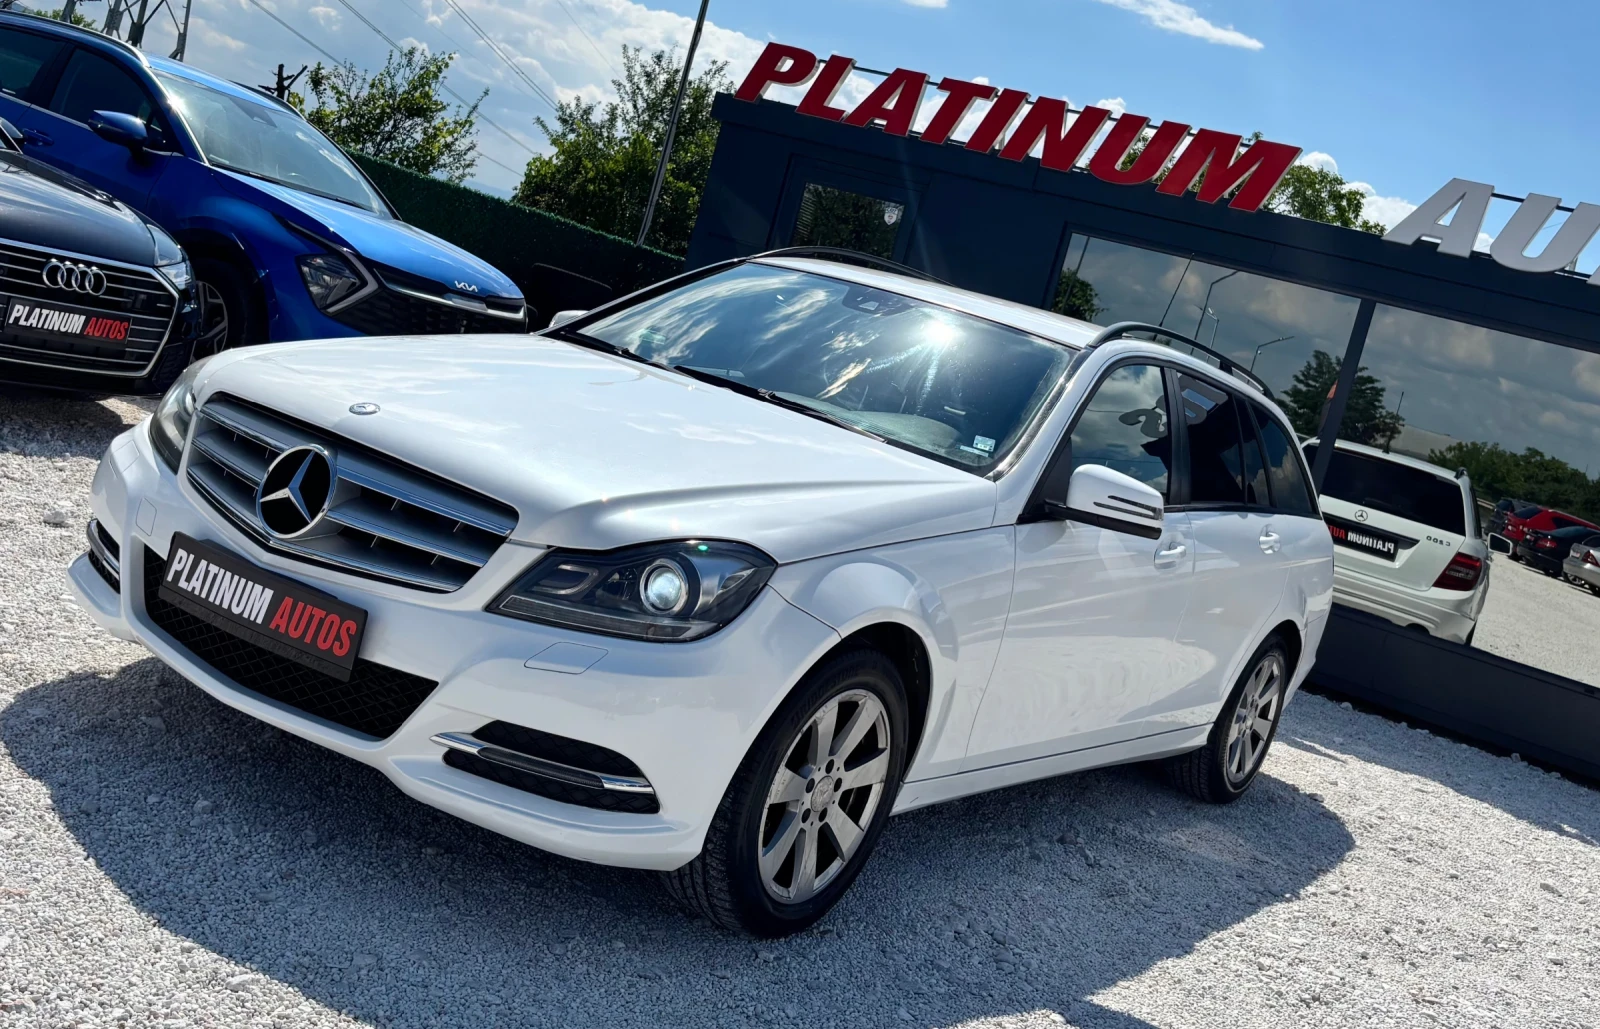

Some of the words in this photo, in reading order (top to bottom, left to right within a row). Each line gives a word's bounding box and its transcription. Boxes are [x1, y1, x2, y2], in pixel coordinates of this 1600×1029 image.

[734, 42, 1303, 212] PLATINUM
[1380, 177, 1600, 286] AU
[8, 304, 87, 334] PLATINUM
[84, 317, 129, 340] AUTOS
[454, 280, 478, 292] KIA
[166, 548, 274, 625] PLATINUM
[269, 596, 357, 657] AUTOS
